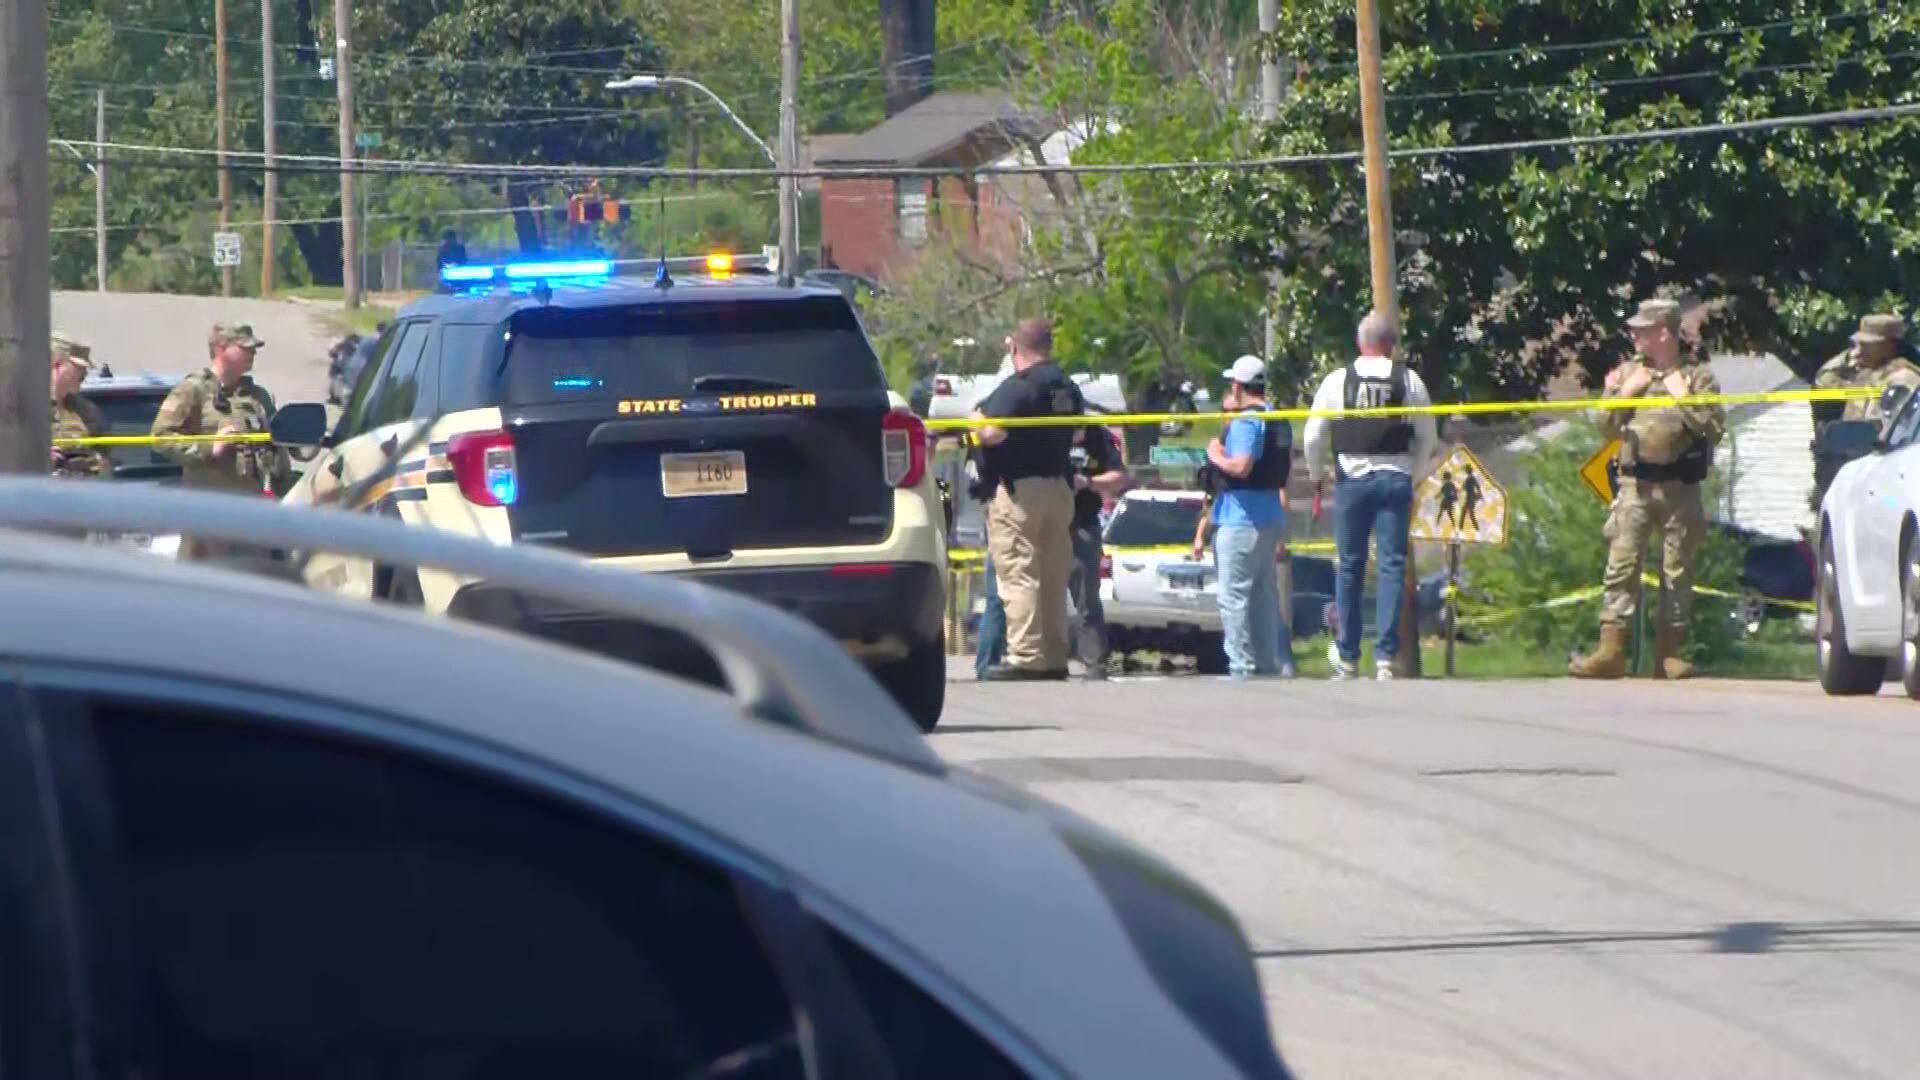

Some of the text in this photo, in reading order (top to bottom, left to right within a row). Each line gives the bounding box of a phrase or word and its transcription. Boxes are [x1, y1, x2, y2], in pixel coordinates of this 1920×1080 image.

[617, 393, 817, 413] STATE TROOPER
[1356, 381, 1392, 408] ATF
[696, 463, 732, 483] 1160
